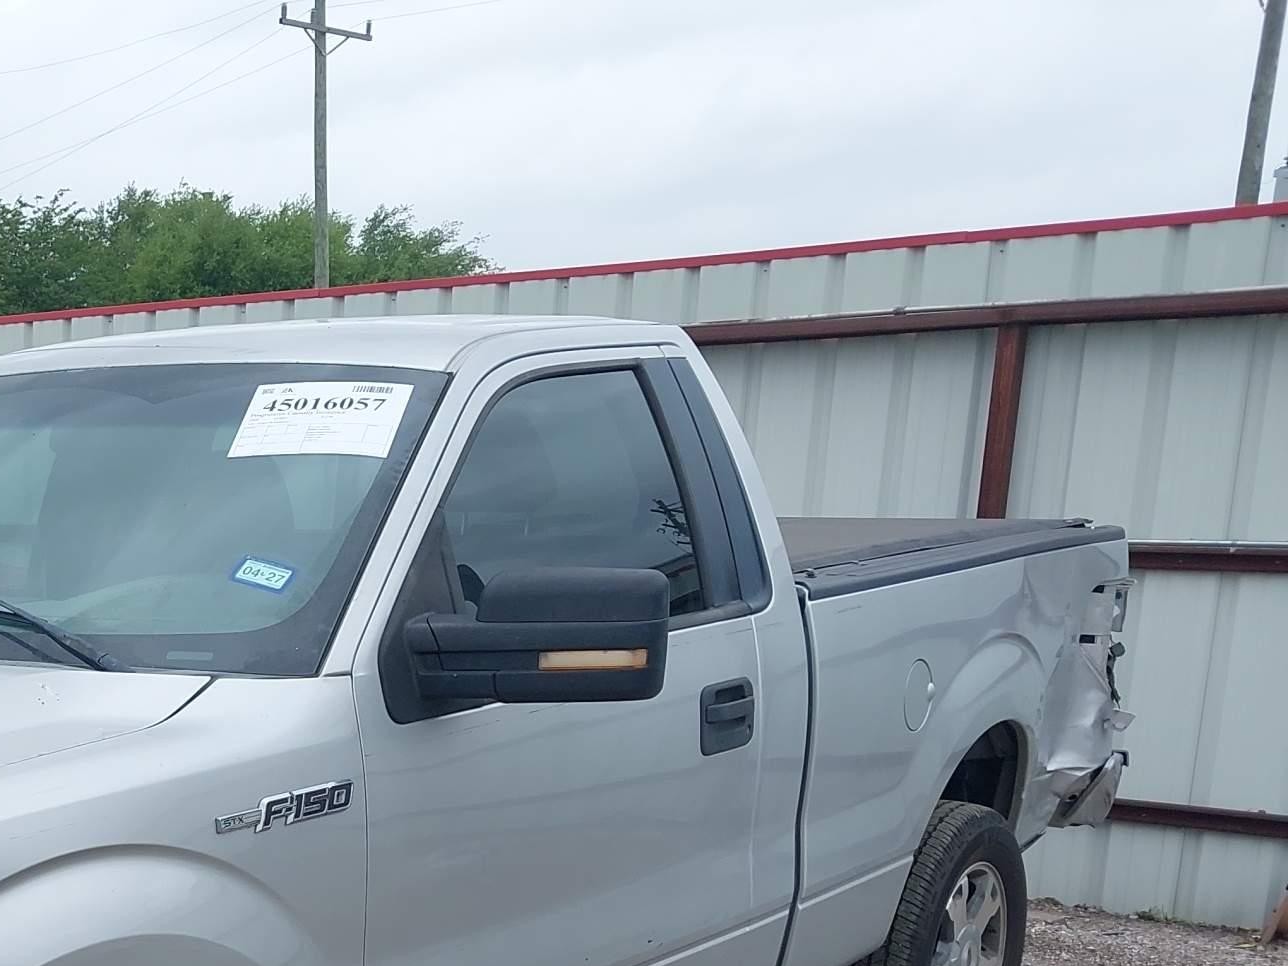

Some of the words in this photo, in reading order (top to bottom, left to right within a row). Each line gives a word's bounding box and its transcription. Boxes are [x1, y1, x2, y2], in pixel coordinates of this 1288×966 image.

[263, 397, 388, 412] 45016057
[223, 815, 244, 828] STX
[255, 779, 354, 833] F-150
